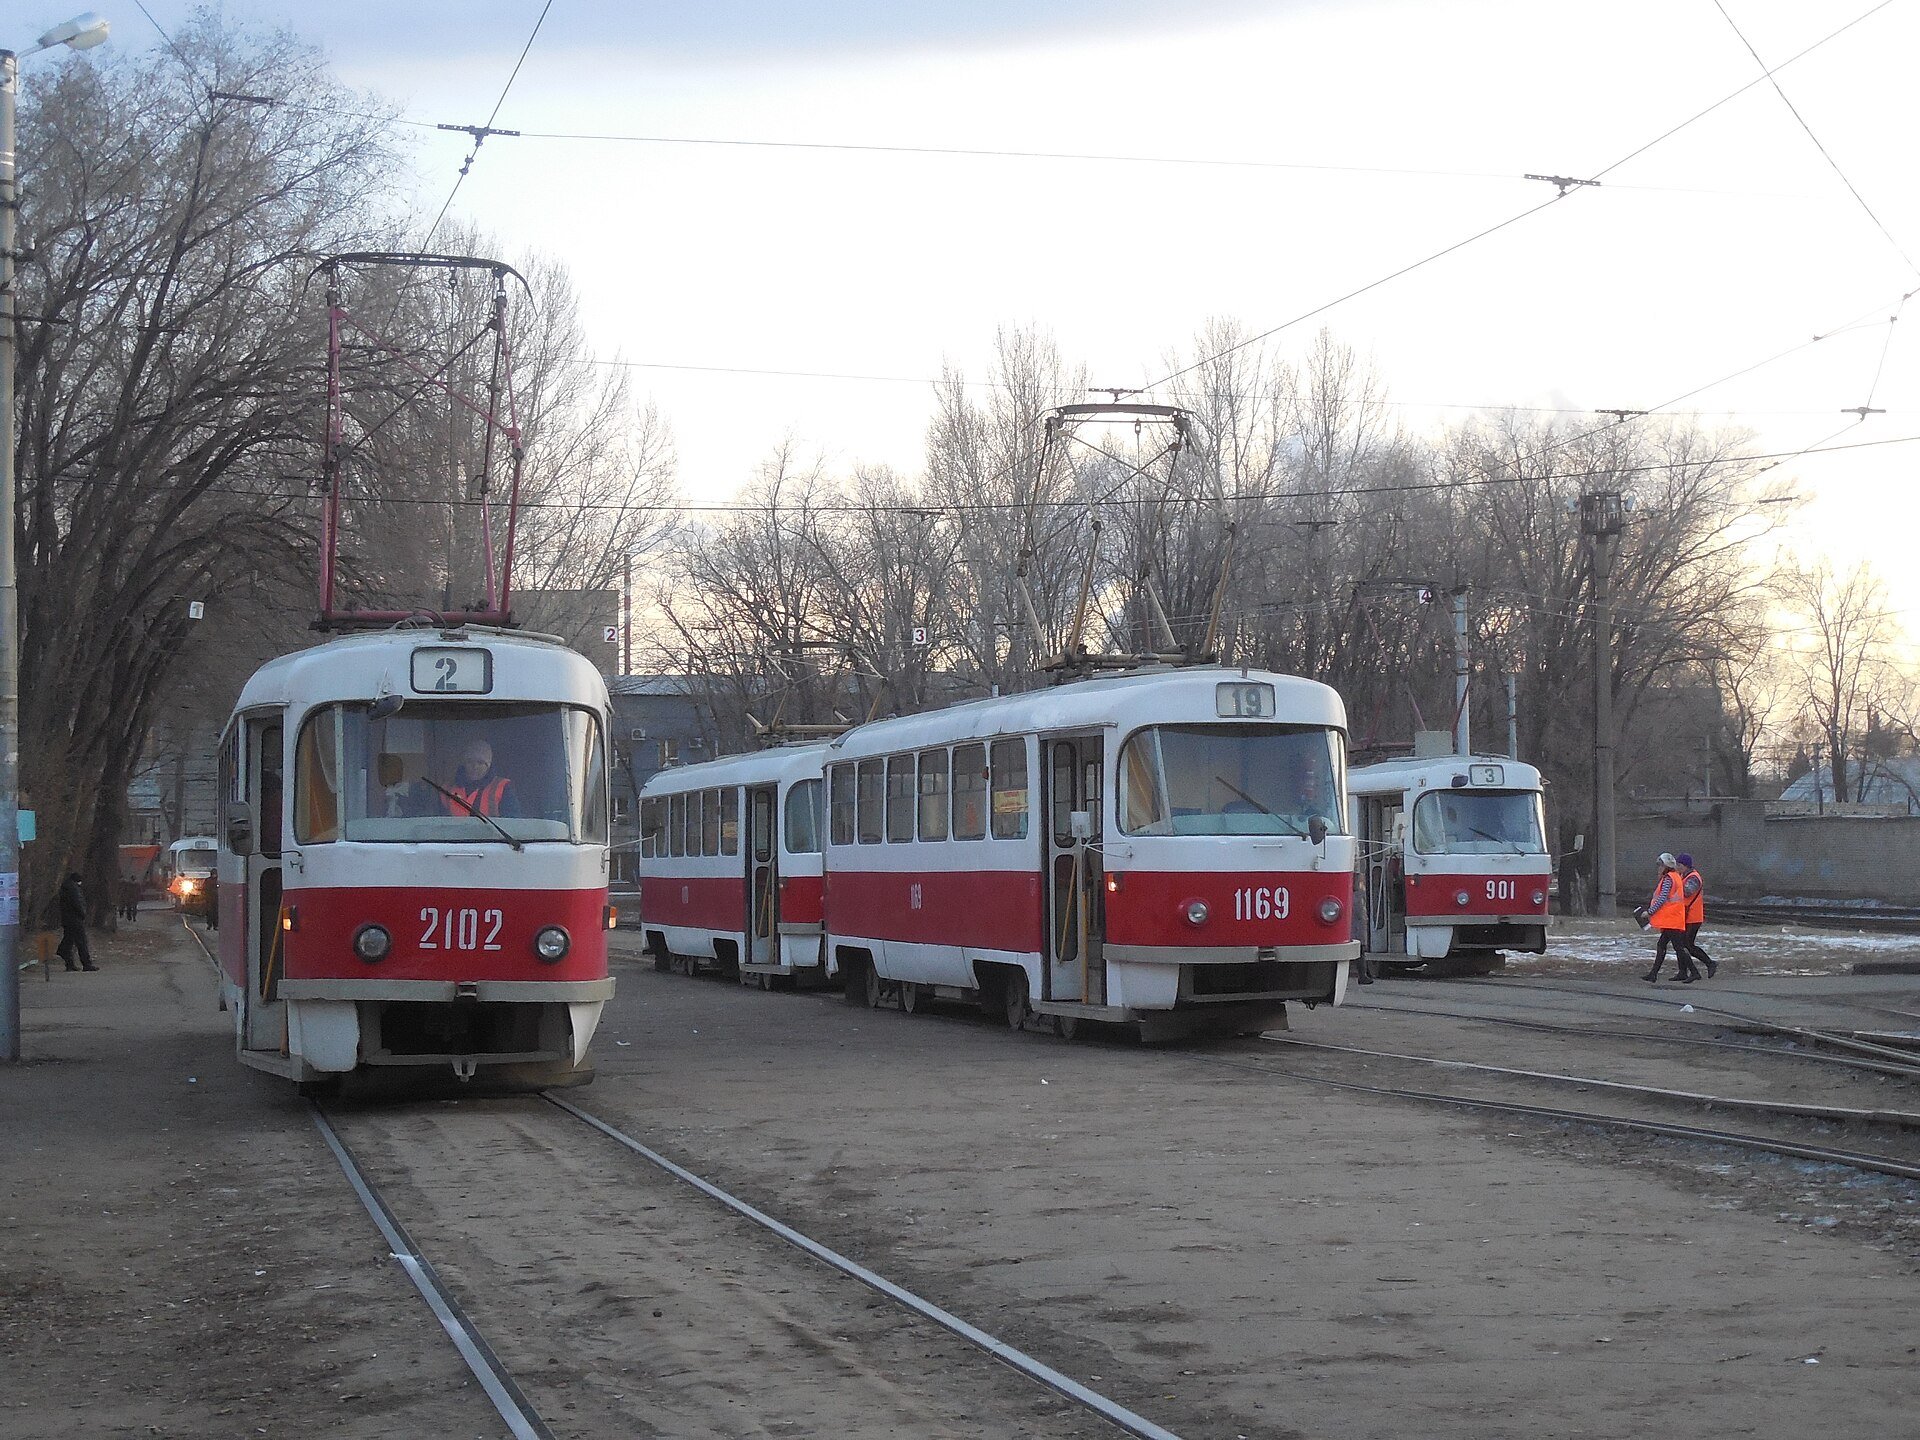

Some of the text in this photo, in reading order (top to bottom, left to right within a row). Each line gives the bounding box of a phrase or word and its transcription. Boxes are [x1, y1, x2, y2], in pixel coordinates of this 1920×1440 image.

[606, 627, 616, 641] 2
[915, 629, 925, 642] 3
[434, 657, 458, 691] 2
[1231, 688, 1262, 716] 19
[1484, 768, 1495, 783] 3
[1486, 880, 1515, 900] 901
[1234, 887, 1289, 921] 1169
[419, 907, 503, 950] 2102
